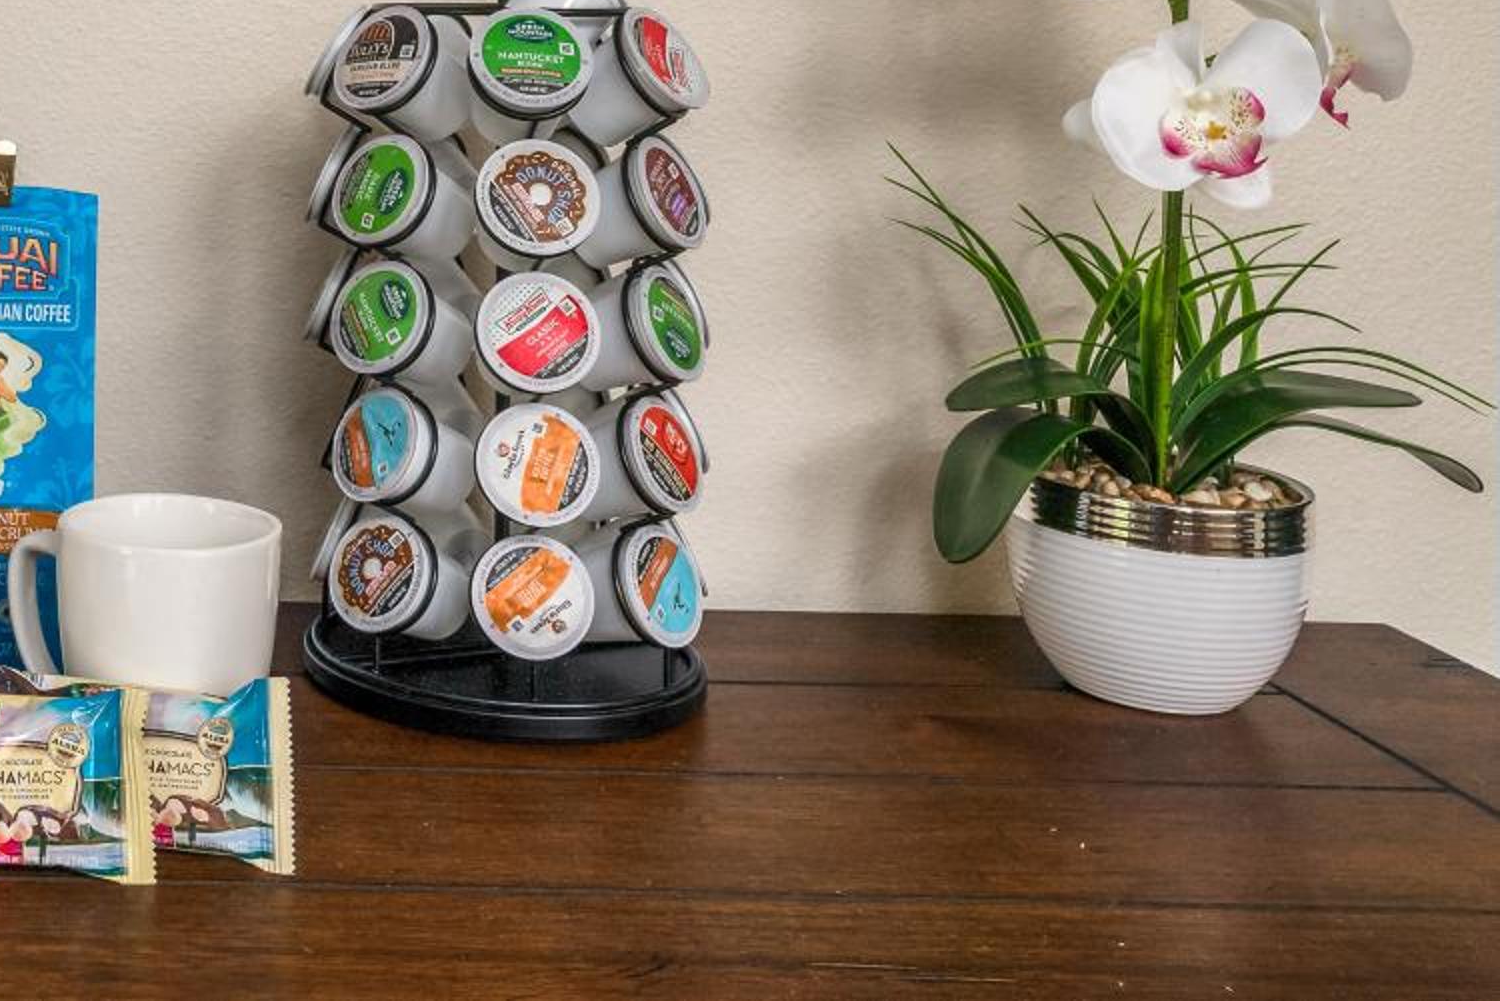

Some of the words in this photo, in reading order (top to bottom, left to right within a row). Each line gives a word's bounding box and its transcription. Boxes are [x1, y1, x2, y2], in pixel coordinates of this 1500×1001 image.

[498, 51, 565, 65] NANTUCKET
[515, 166, 568, 184] DONUT
[25, 304, 71, 323] COFFEE
